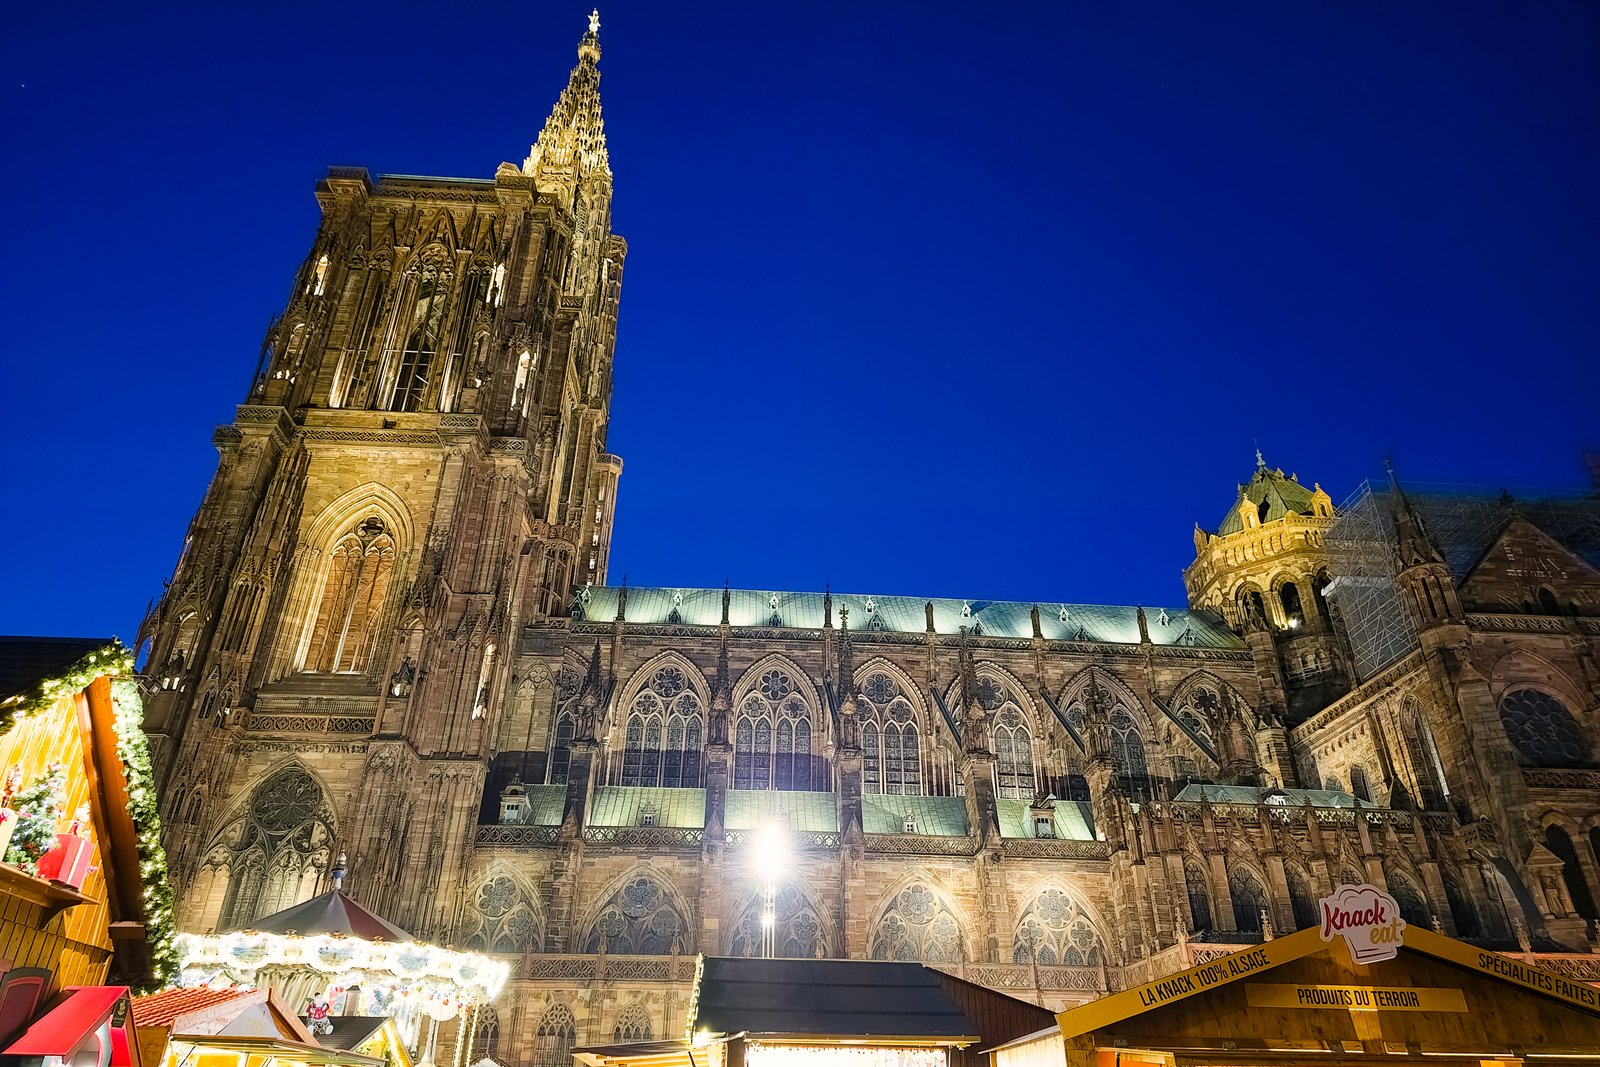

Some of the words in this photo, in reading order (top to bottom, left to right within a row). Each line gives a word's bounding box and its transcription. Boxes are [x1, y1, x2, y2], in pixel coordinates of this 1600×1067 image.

[1324, 898, 1387, 937] Knack
[1369, 916, 1402, 944] eat
[1139, 988, 1157, 1007] LA
[1155, 973, 1196, 1002] KNACK
[1194, 963, 1229, 988] 100%
[1227, 949, 1271, 977] ALSACE
[1478, 952, 1552, 991] SPÉCIALITÉS
[1555, 978, 1595, 1006] FAITES
[1297, 988, 1353, 1006] PRODUITS
[1353, 990, 1370, 1006] DU
[1371, 990, 1420, 1008] TERROIR
